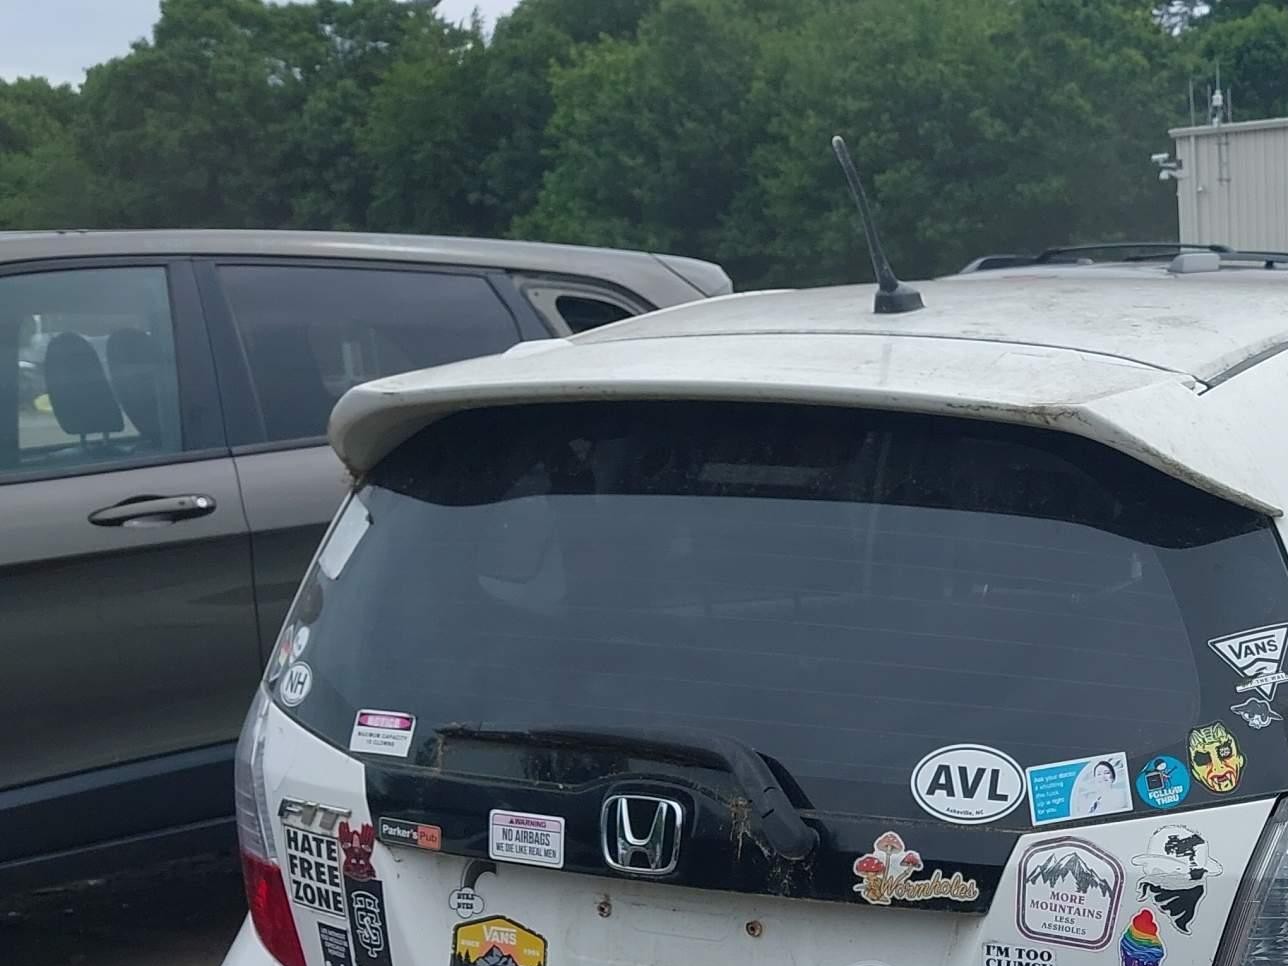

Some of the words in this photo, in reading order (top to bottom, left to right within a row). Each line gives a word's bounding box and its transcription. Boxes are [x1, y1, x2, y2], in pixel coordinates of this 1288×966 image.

[1228, 634, 1278, 660] VANS
[285, 670, 307, 695] NH
[926, 764, 1009, 802] AVL
[382, 824, 418, 840] Parker's
[420, 831, 437, 842] Pub
[513, 818, 547, 829] WARNING
[286, 828, 338, 862] HATE
[502, 828, 513, 842] NO
[515, 830, 551, 846] AIRBAGS
[496, 842, 504, 852] WE
[515, 844, 527, 854] LIKE
[528, 846, 542, 856] REAL
[544, 848, 557, 858] MEN
[288, 853, 340, 888] FREE
[292, 878, 344, 913] ZONE
[1049, 891, 1086, 905] MORE
[1030, 899, 1103, 920] MOUNTAINS
[1041, 922, 1086, 935] ASSHOLES
[1054, 915, 1075, 925] LESS
[482, 924, 517, 945] VANS
[985, 944, 1010, 958] I'M
[1015, 948, 1053, 962] TOO
